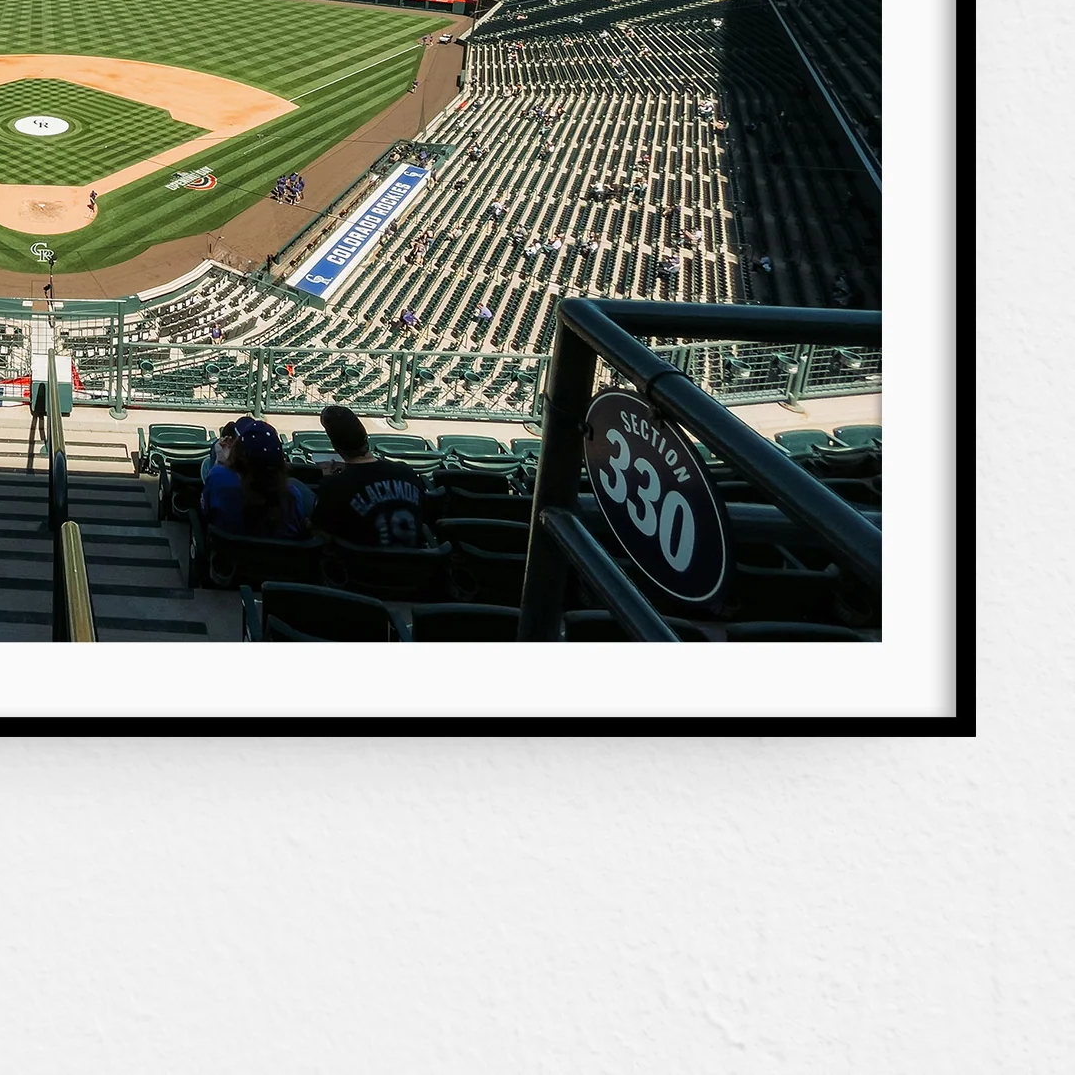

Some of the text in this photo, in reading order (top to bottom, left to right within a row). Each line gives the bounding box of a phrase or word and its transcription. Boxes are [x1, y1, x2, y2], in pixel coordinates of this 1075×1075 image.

[326, 182, 412, 266] COLORADO ROCKIES
[619, 410, 691, 483] SECTION
[599, 428, 696, 573] 330
